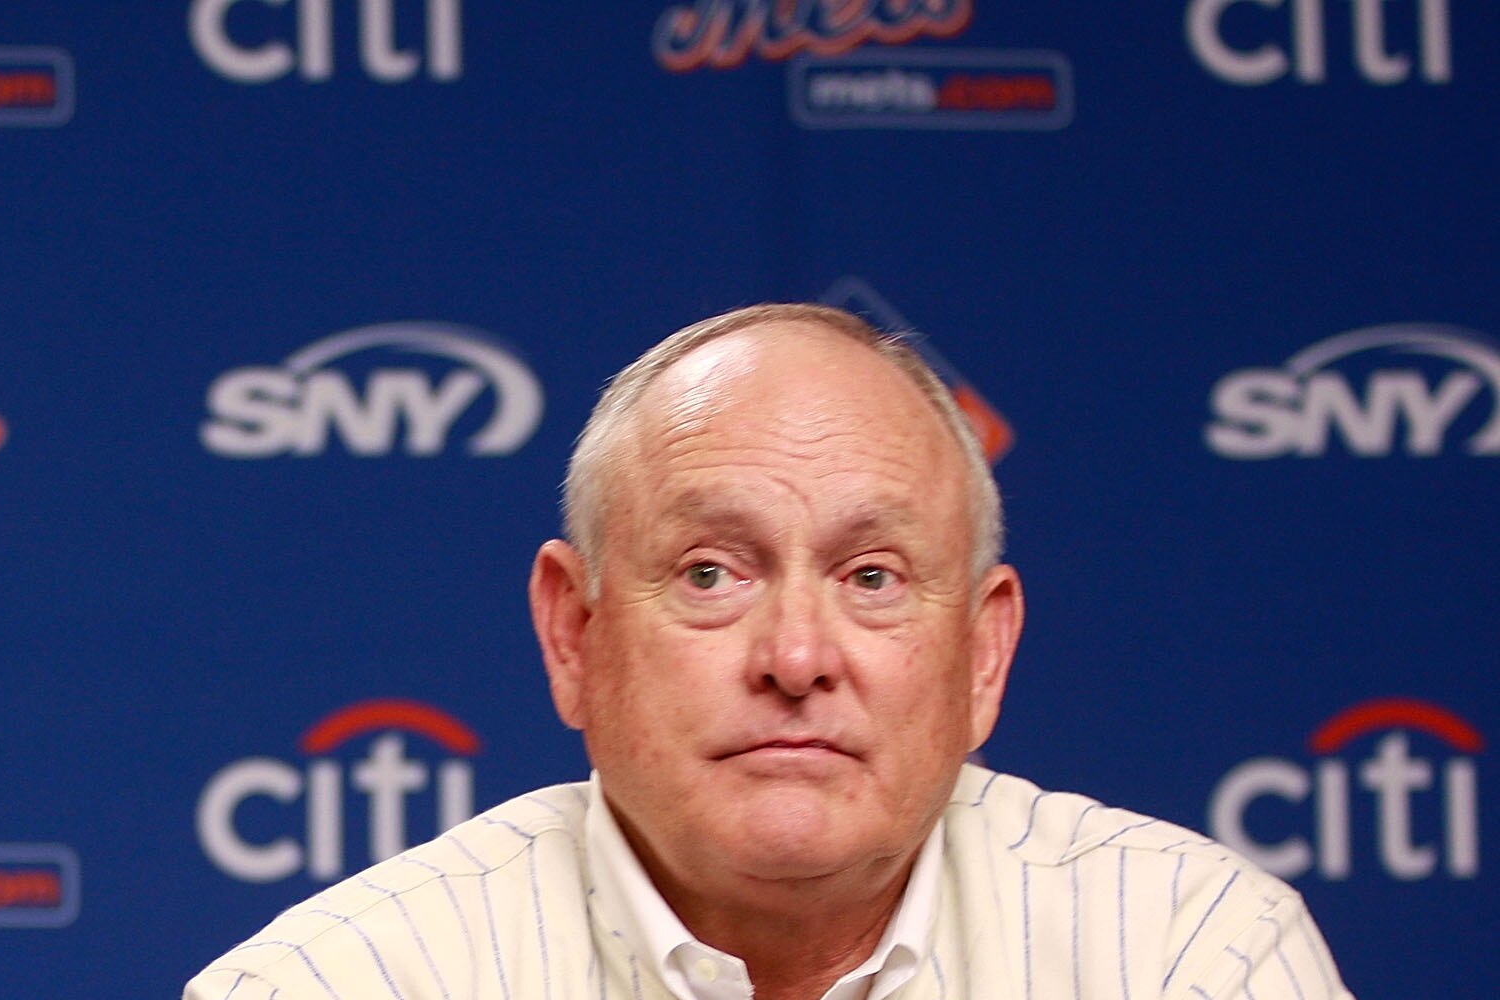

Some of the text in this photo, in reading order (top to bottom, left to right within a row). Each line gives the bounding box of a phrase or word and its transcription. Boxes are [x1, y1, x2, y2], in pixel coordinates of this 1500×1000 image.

[808, 70, 1056, 112] mets.com
[200, 364, 488, 458] SNY
[1204, 366, 1486, 460] SNY
[196, 732, 477, 884] citi
[1208, 728, 1479, 882] citi
